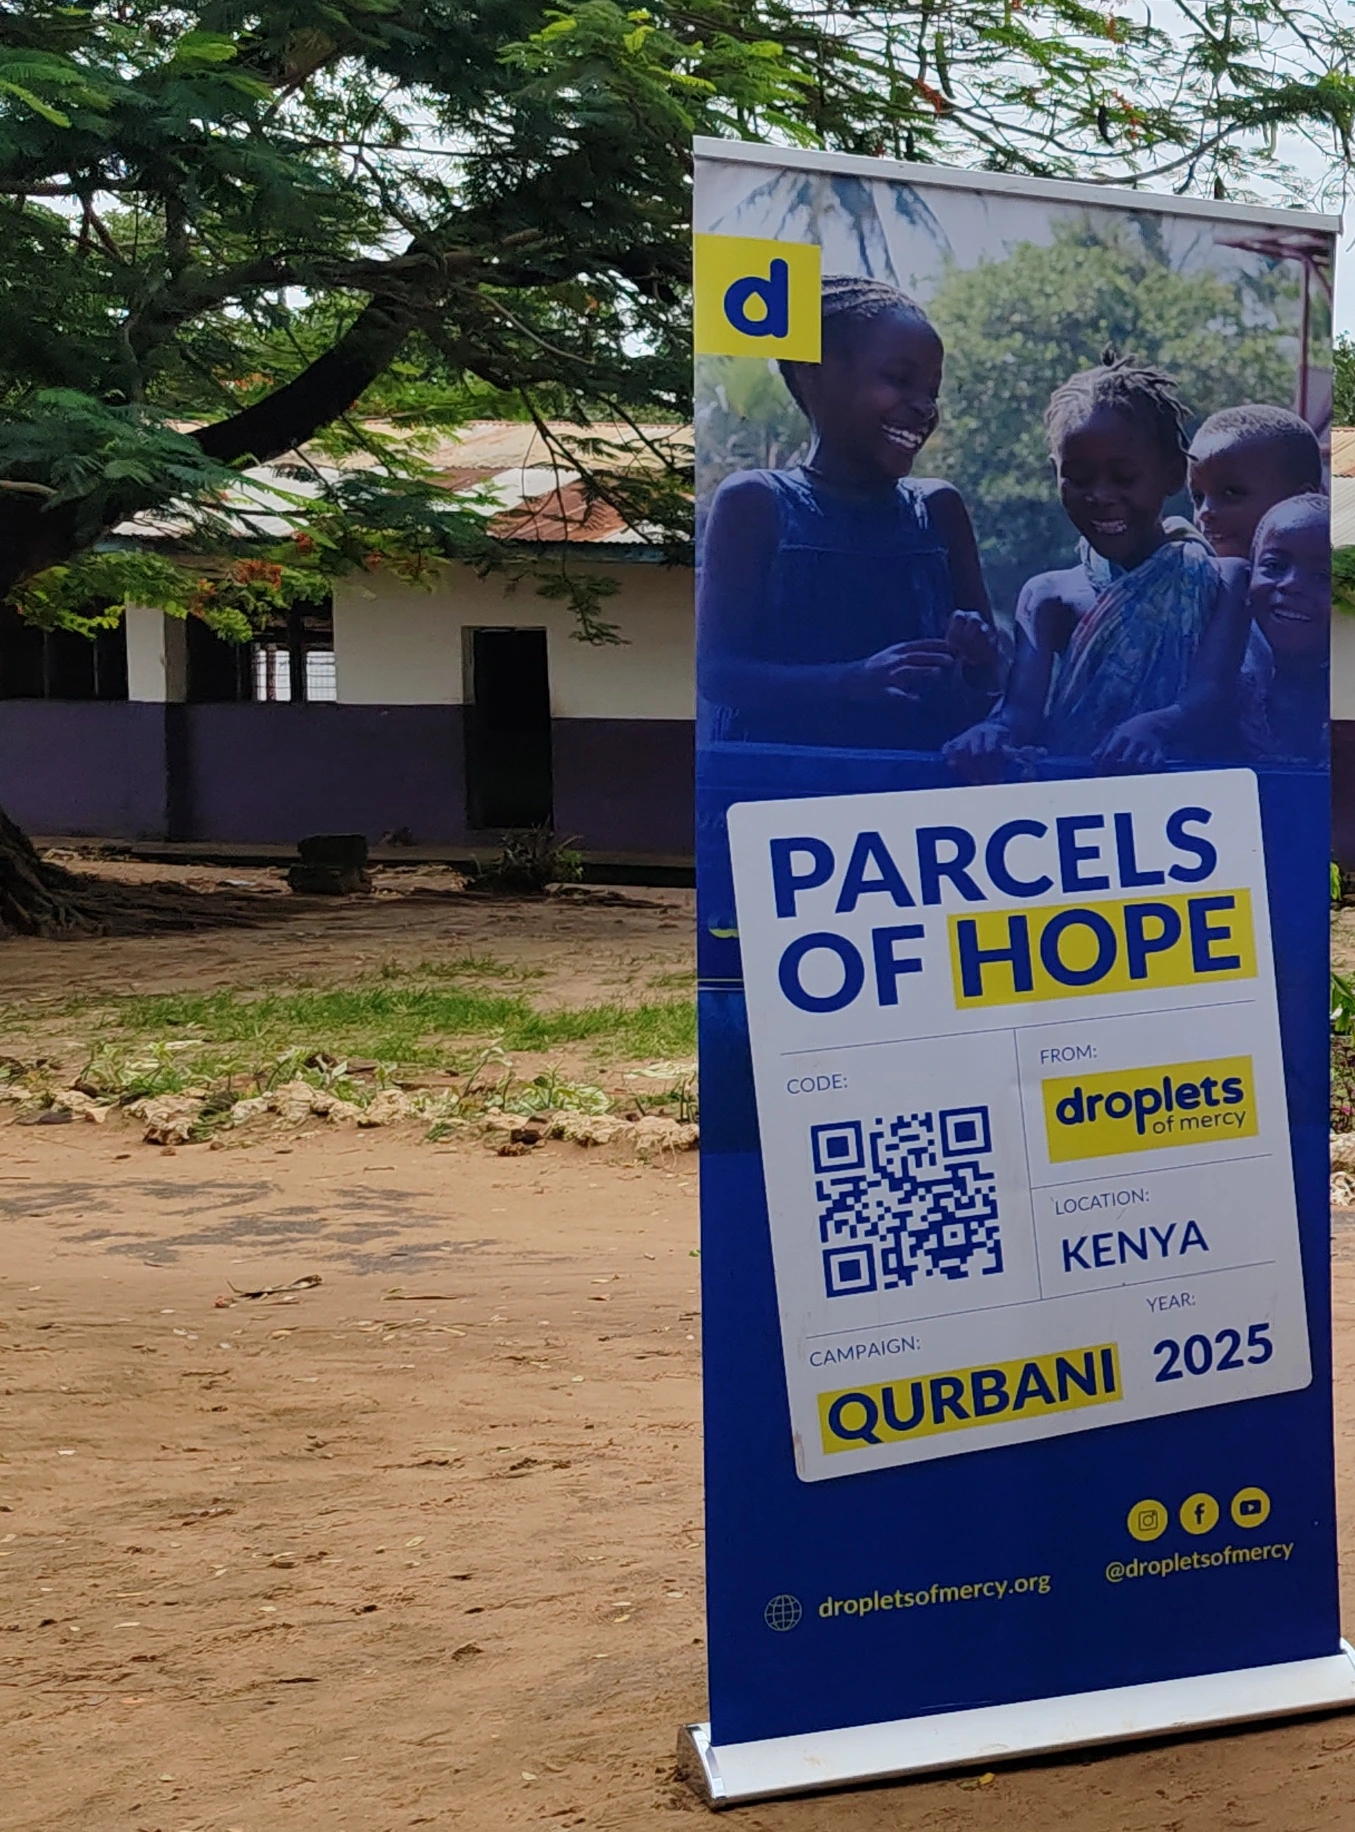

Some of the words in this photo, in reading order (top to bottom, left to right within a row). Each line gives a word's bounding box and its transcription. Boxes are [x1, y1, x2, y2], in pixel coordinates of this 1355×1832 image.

[723, 258, 789, 339] d
[769, 806, 1218, 918] PARCELS
[777, 924, 925, 1013] OF
[956, 895, 1242, 998] HOPE
[1040, 1044, 1098, 1065] FROM:
[786, 1073, 849, 1095] CODE:
[1055, 1075, 1244, 1135] droplets
[1152, 1115, 1175, 1134] of
[1180, 1110, 1247, 1131] mercy
[1054, 1189, 1151, 1216] LOCATION:
[1062, 1220, 1210, 1273] KENYA
[1146, 1292, 1197, 1313] YEAR:
[808, 1335, 922, 1367] CAMPAIGN:
[1153, 1322, 1273, 1383] 2025
[827, 1348, 1117, 1443] QURBANI
[1105, 1541, 1295, 1583] @dropletsofmercy
[818, 1573, 1052, 1619] dropletsofmercy.org
